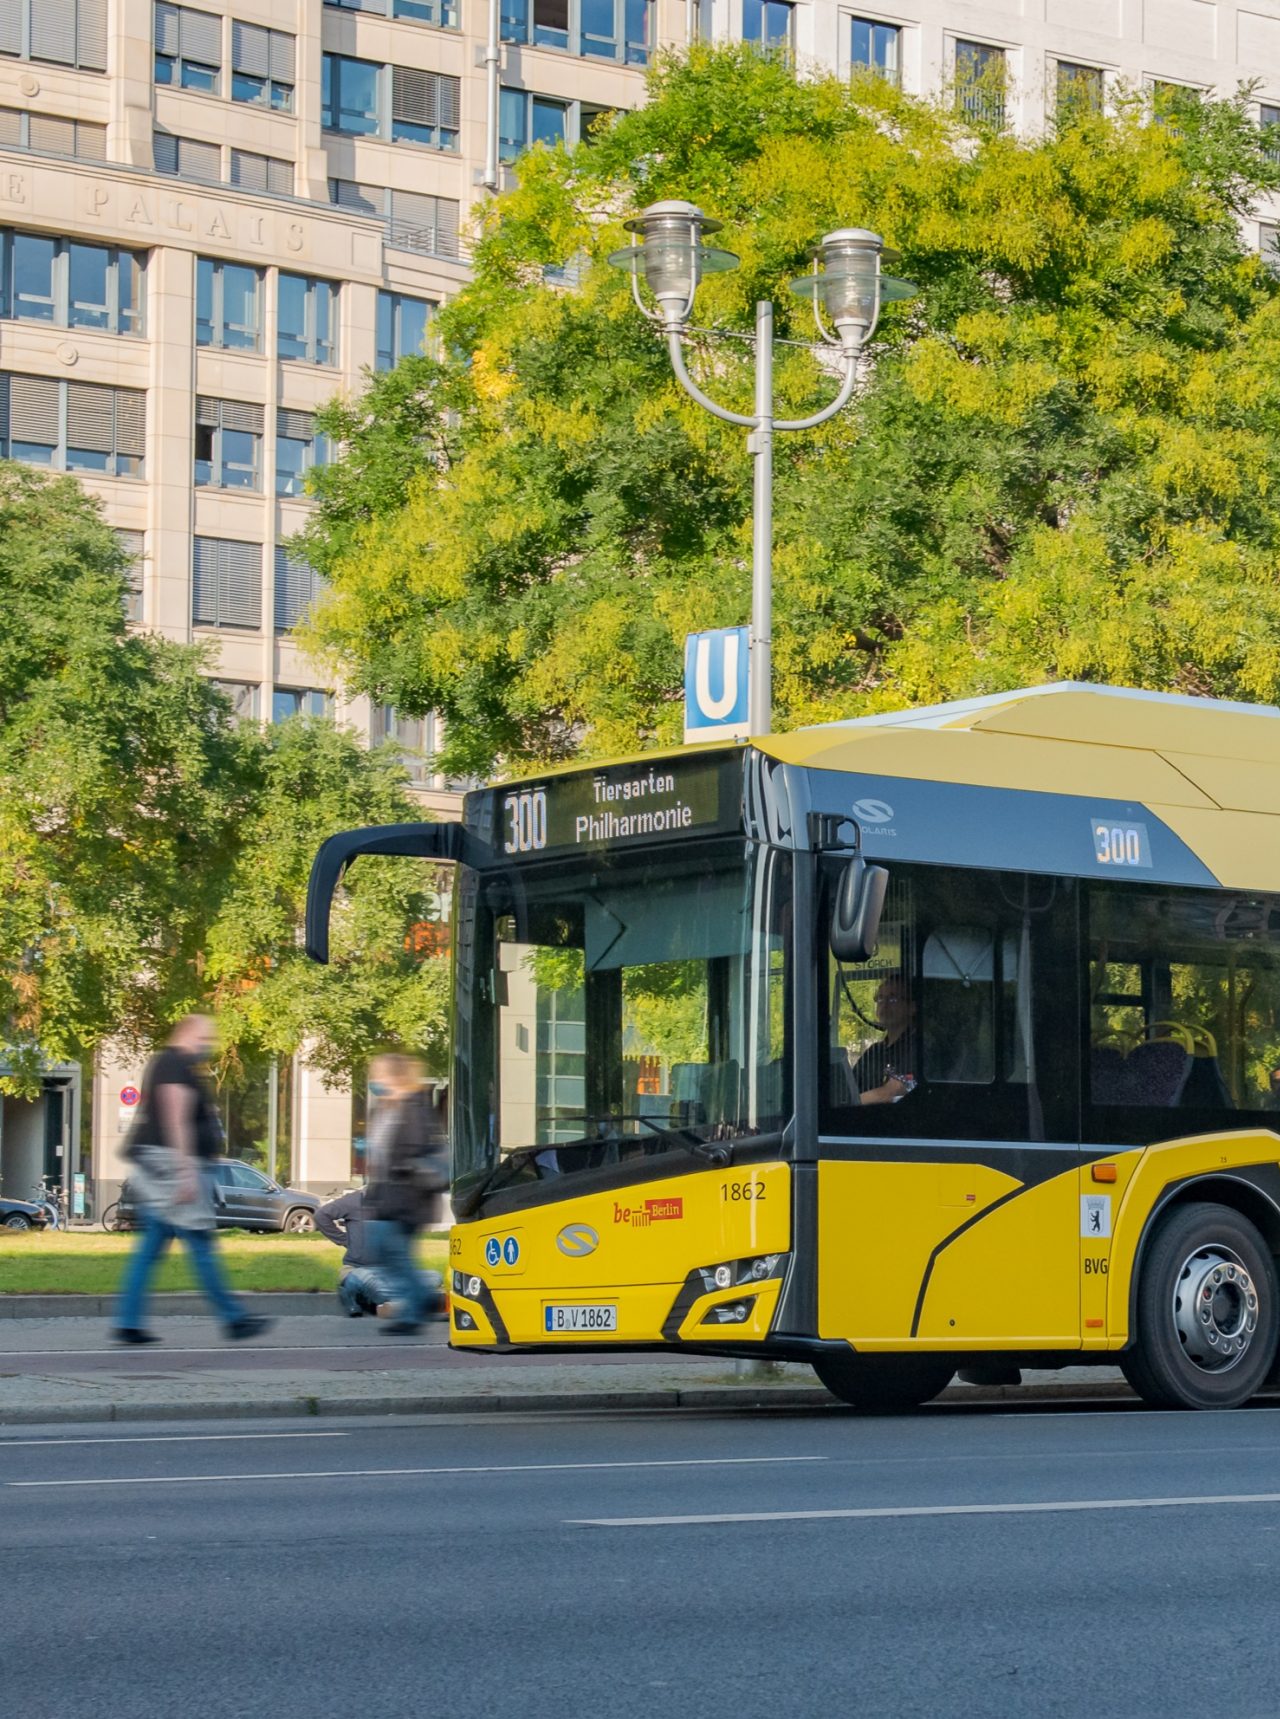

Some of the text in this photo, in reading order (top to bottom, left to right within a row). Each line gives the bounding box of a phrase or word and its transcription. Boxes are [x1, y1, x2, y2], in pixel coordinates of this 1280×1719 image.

[85, 186, 304, 251] PALAIS
[696, 635, 741, 720] U
[593, 768, 675, 804] Tiergarten
[504, 786, 548, 855] 300
[575, 801, 693, 843] Philharmonie
[860, 826, 897, 836] OLARIS
[1096, 826, 1140, 866] 300
[720, 1182, 767, 1202] 1862
[613, 1201, 680, 1224] be Berlin
[1084, 1258, 1108, 1275] BVG
